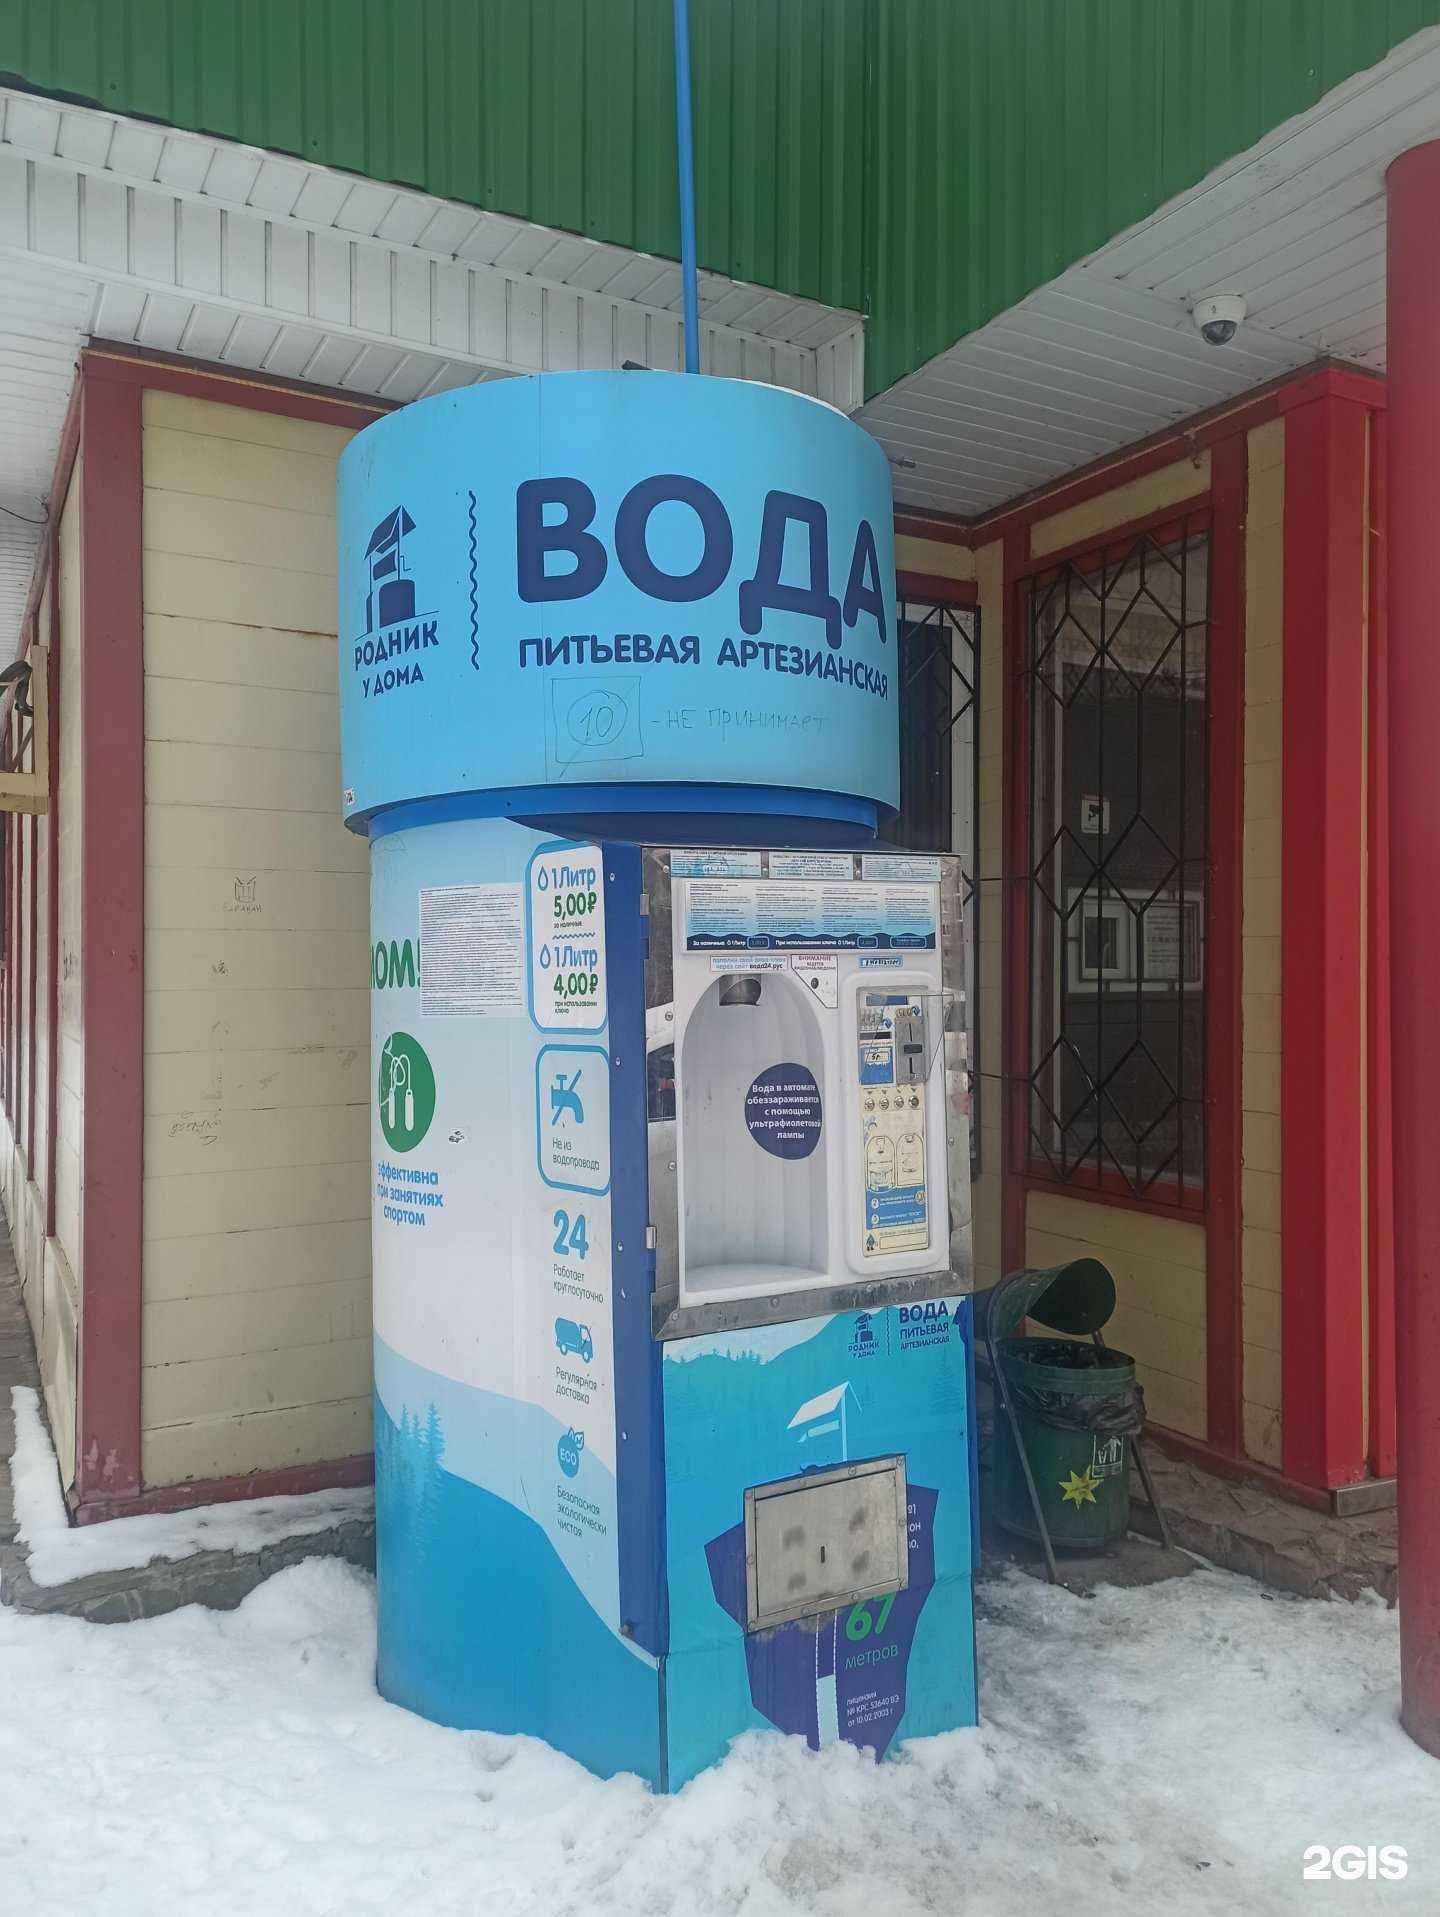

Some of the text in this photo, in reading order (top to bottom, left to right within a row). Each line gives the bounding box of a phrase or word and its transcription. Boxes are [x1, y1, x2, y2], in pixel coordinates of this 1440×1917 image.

[516, 474, 887, 649] ВОДА
[354, 620, 440, 672] РОДНИК
[519, 634, 889, 700] ПИТЬЕВАЯ АРТЕЗИАНСКАЯ
[362, 661, 424, 699] У ДОМА
[579, 706, 614, 738] 10
[369, 937, 420, 990] ОМ!
[752, 1084, 775, 1094] Вода
[552, 1137, 572, 1152] Не из
[552, 1153, 600, 1172] водопровода
[389, 1187, 444, 1208] занятиях
[383, 1204, 426, 1227] спортом
[552, 1208, 590, 1260] 24
[553, 1263, 585, 1283] Работает
[899, 1300, 949, 1324] ВОДА
[900, 1322, 949, 1341] ПИТЬЕВАЯ
[559, 1447, 577, 1466] ECO
[845, 1592, 897, 1641] 67
[845, 1644, 899, 1670] метров
